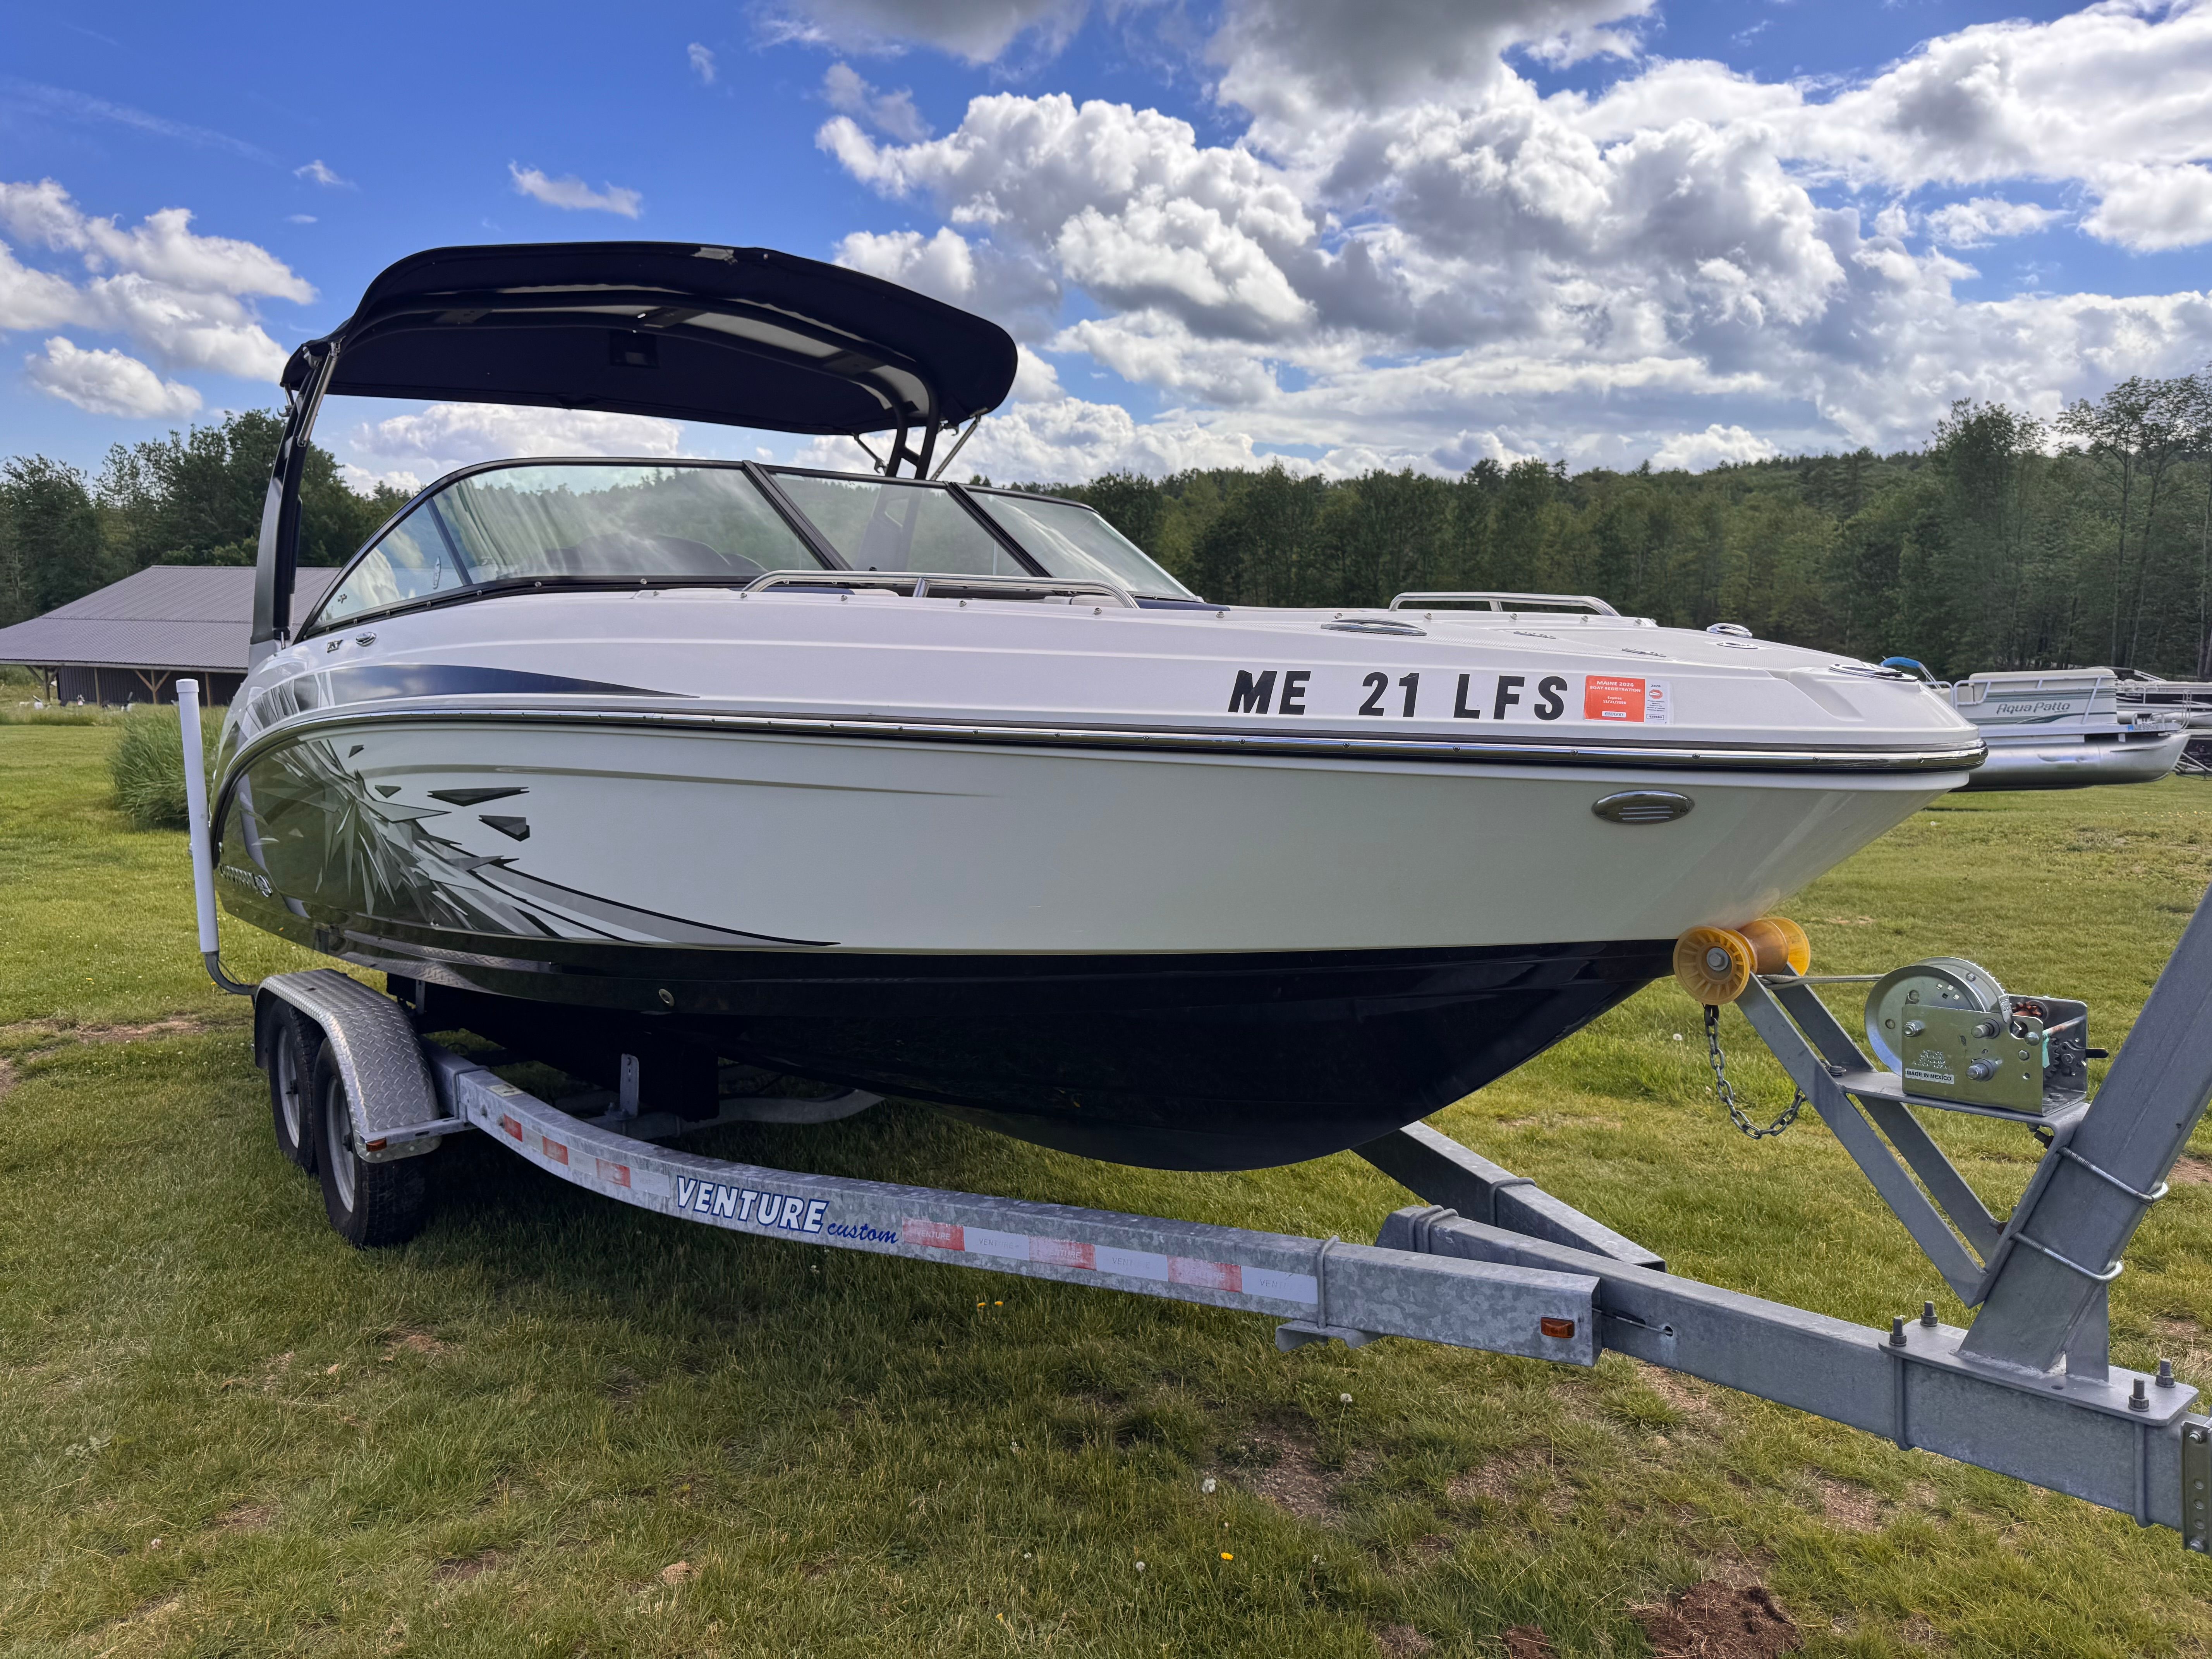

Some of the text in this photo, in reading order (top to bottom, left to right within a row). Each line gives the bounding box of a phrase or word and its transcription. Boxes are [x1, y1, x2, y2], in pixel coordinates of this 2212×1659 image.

[1228, 670, 1568, 721] ME 21 LFS
[677, 1175, 899, 1244] VENTURE custom
[916, 1229, 951, 1240] VENTURE
[1112, 1256, 1150, 1269] VENTE
